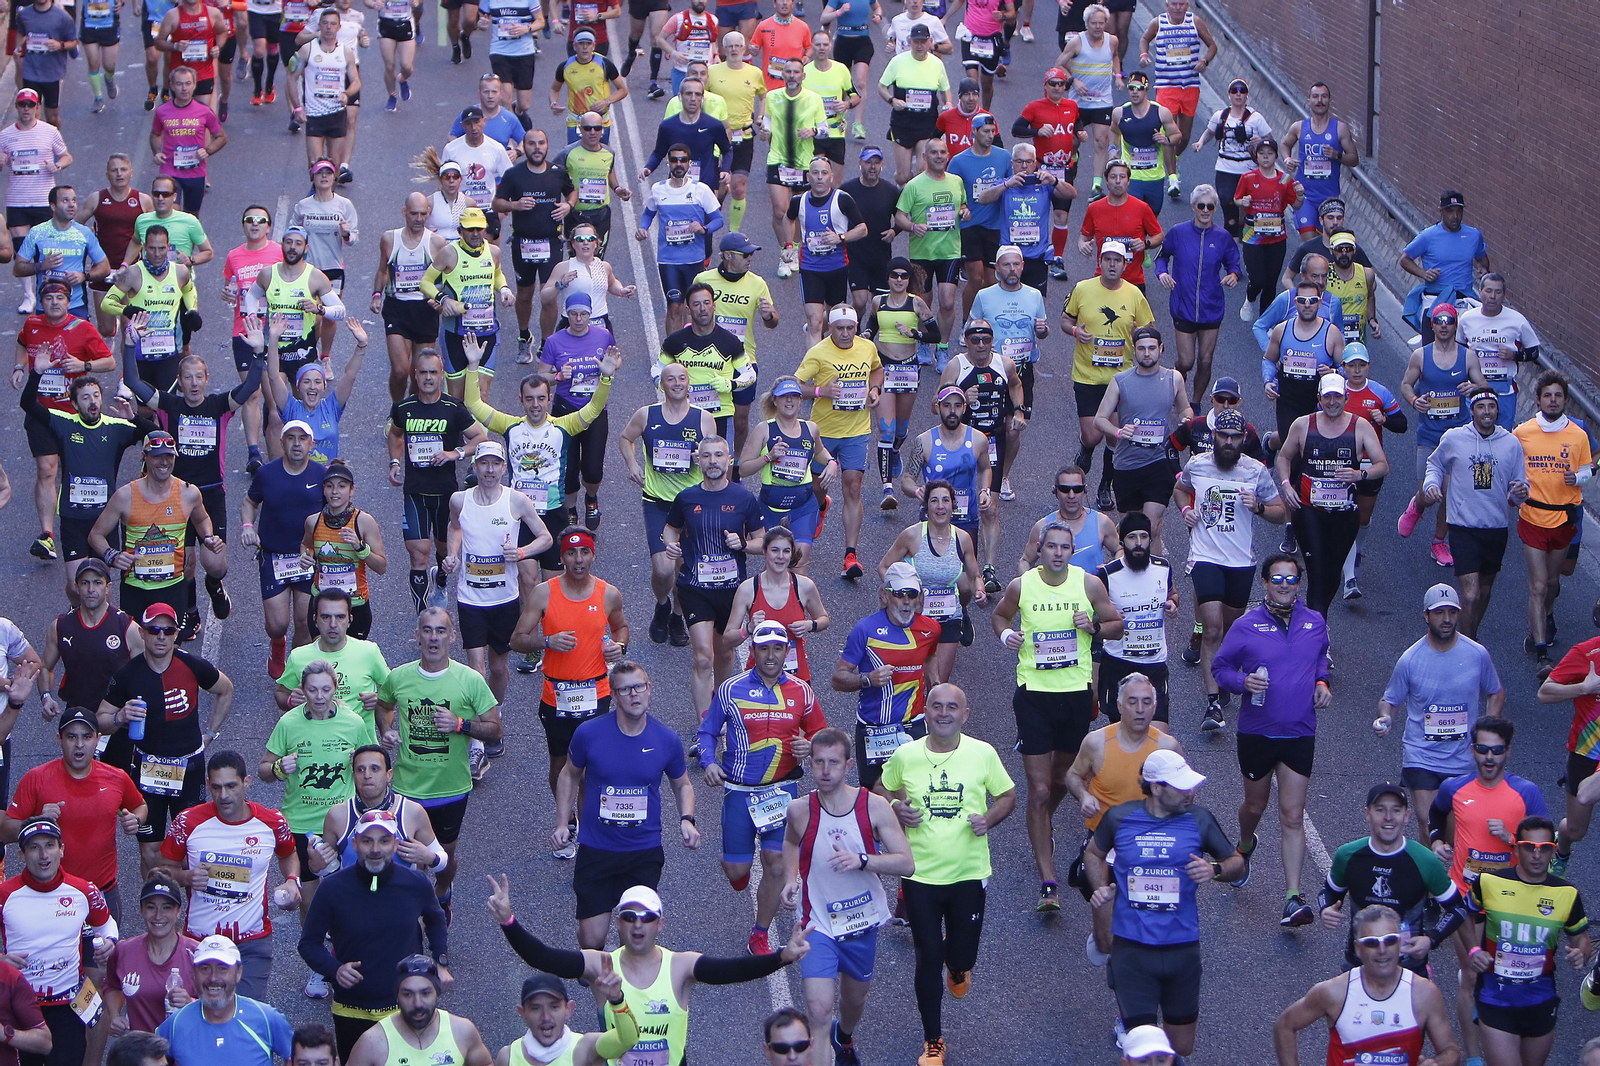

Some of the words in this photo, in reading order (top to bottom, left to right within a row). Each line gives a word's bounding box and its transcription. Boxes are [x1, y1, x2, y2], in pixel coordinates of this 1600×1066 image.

[182, 118, 200, 126] SOMOS
[168, 128, 197, 137] LIEBRES
[721, 292, 750, 305] asics
[838, 370, 867, 380] ULTRA
[406, 418, 448, 432] WRP20
[786, 449, 808, 457] ZURICH
[1226, 501, 1235, 523] VIDA
[1216, 524, 1236, 532] TEAM
[147, 546, 171, 554] ZURICH
[478, 555, 500, 563] ZURICH
[1032, 602, 1080, 612] CALLUM
[1047, 632, 1072, 640] ZURICH
[566, 680, 591, 690] ZURICH
[567, 695, 584, 704] 9882
[874, 726, 897, 736] ZURICH
[874, 740, 896, 748] 13424
[155, 770, 172, 778] 3340
[762, 800, 783, 814] 13828
[768, 812, 784, 822] SALVA
[218, 855, 248, 865] ZURICH
[215, 870, 236, 880] 4958
[1144, 868, 1174, 876] ZURICH
[214, 881, 232, 889] ELYES
[1144, 883, 1164, 892] 6431
[843, 894, 870, 909] ZURICH
[846, 911, 865, 920] 9401
[845, 920, 869, 932] LIENARD
[1513, 946, 1542, 954] ZURICH
[632, 1042, 664, 1050] ZURICH
[1374, 1055, 1404, 1064] ZURICH
